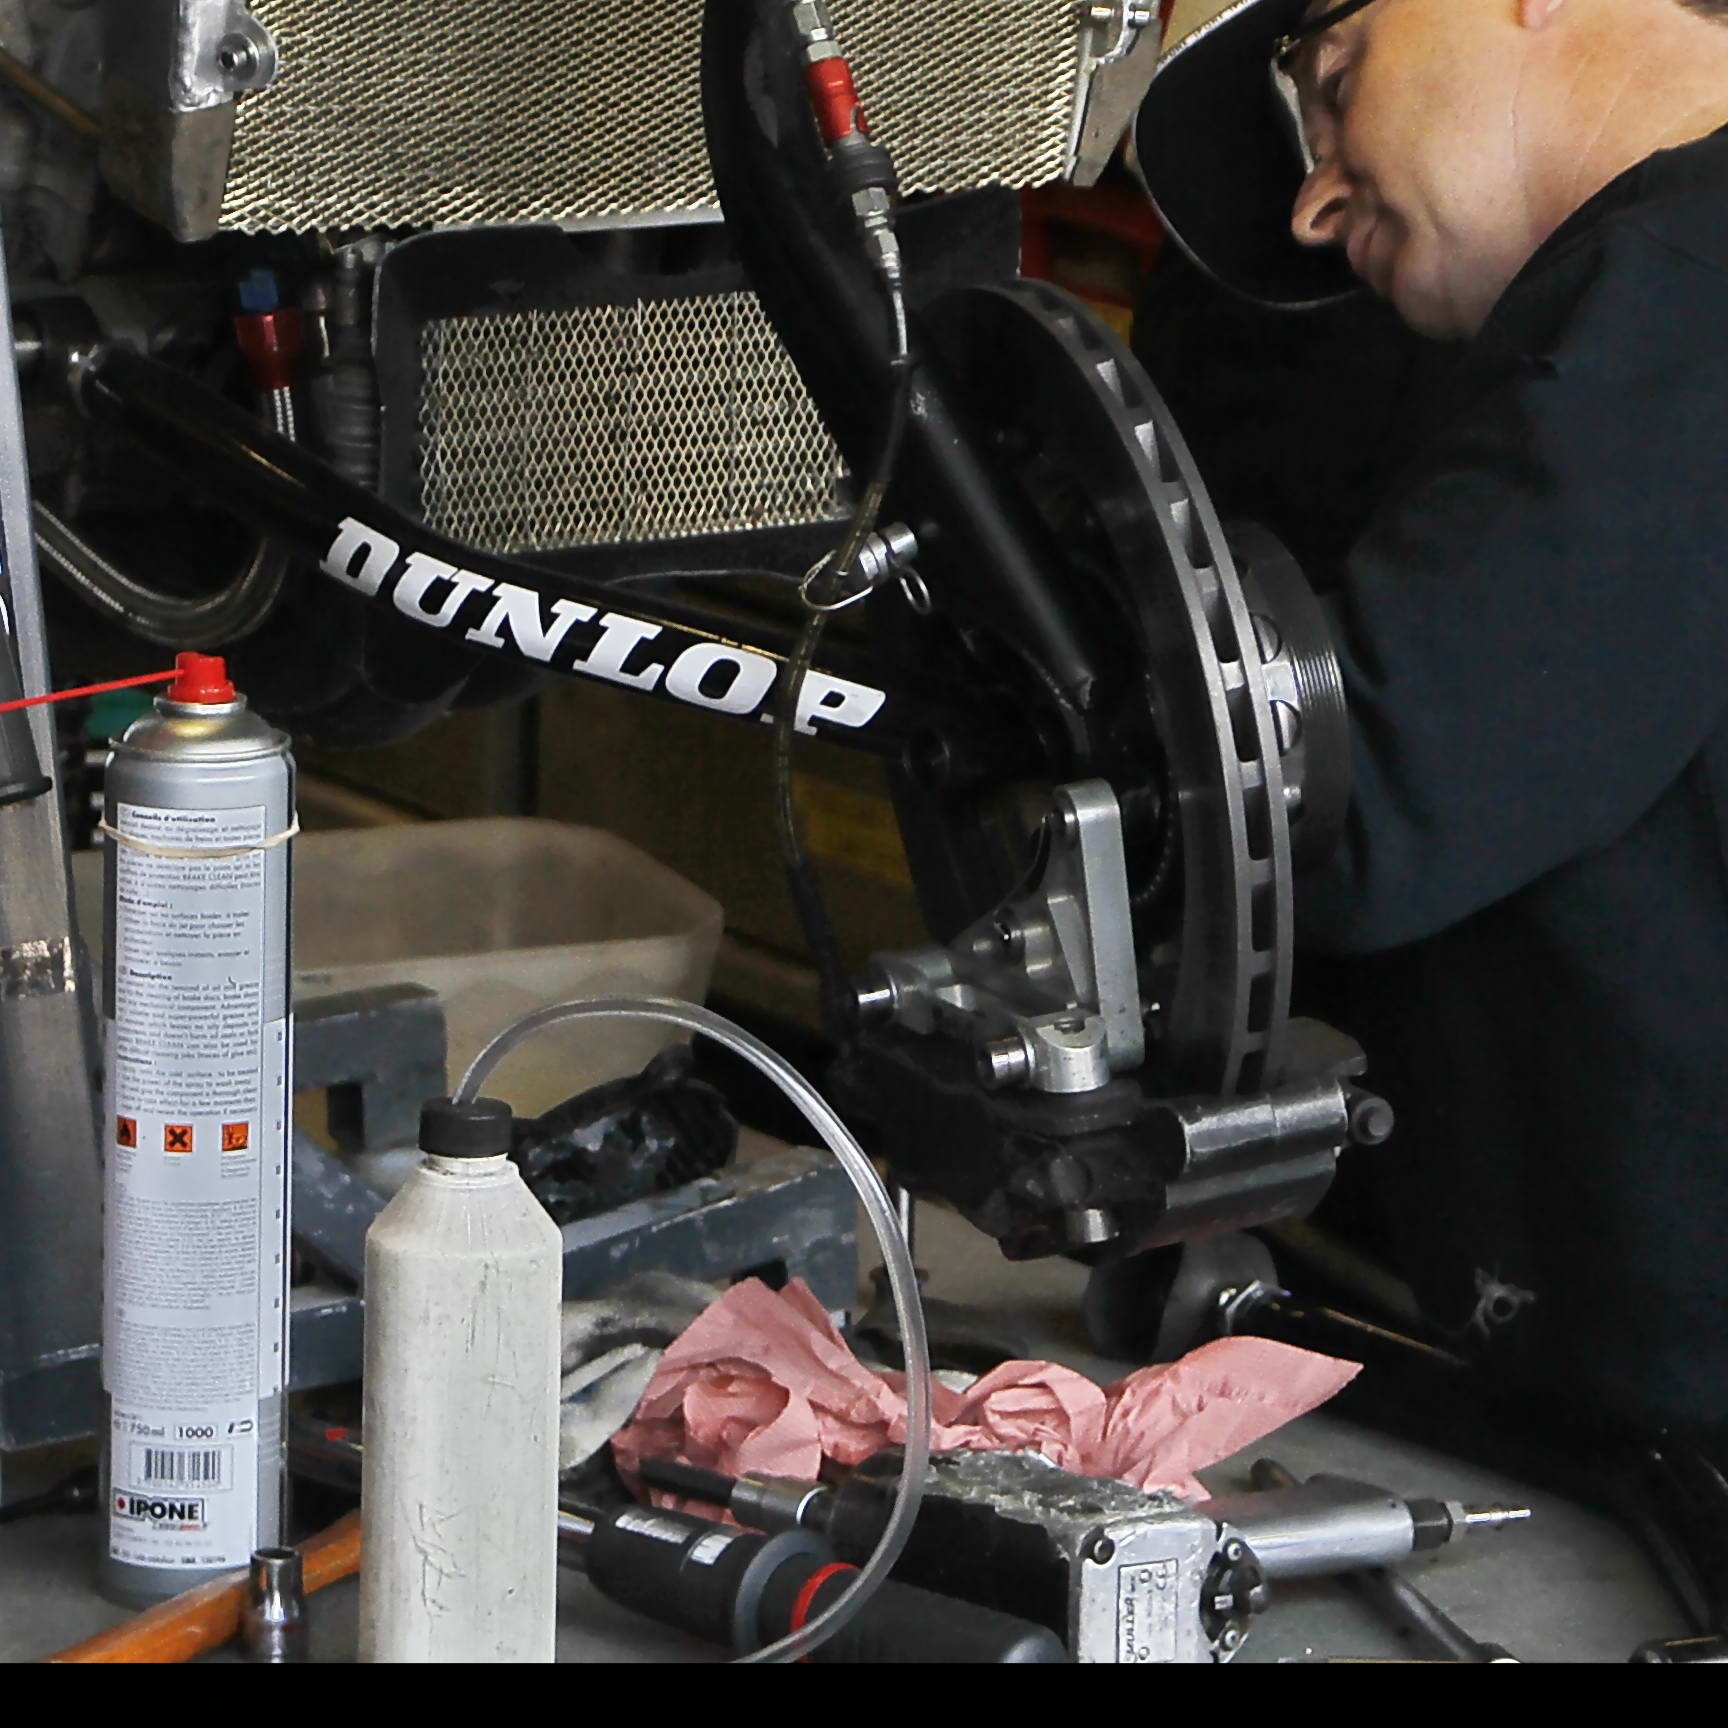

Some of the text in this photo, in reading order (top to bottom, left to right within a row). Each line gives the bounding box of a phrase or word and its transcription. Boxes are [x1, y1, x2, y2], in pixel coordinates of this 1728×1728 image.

[318, 515, 886, 737] DUNLOP
[178, 1426, 214, 1438] 1000
[129, 1497, 200, 1520] IPONE
